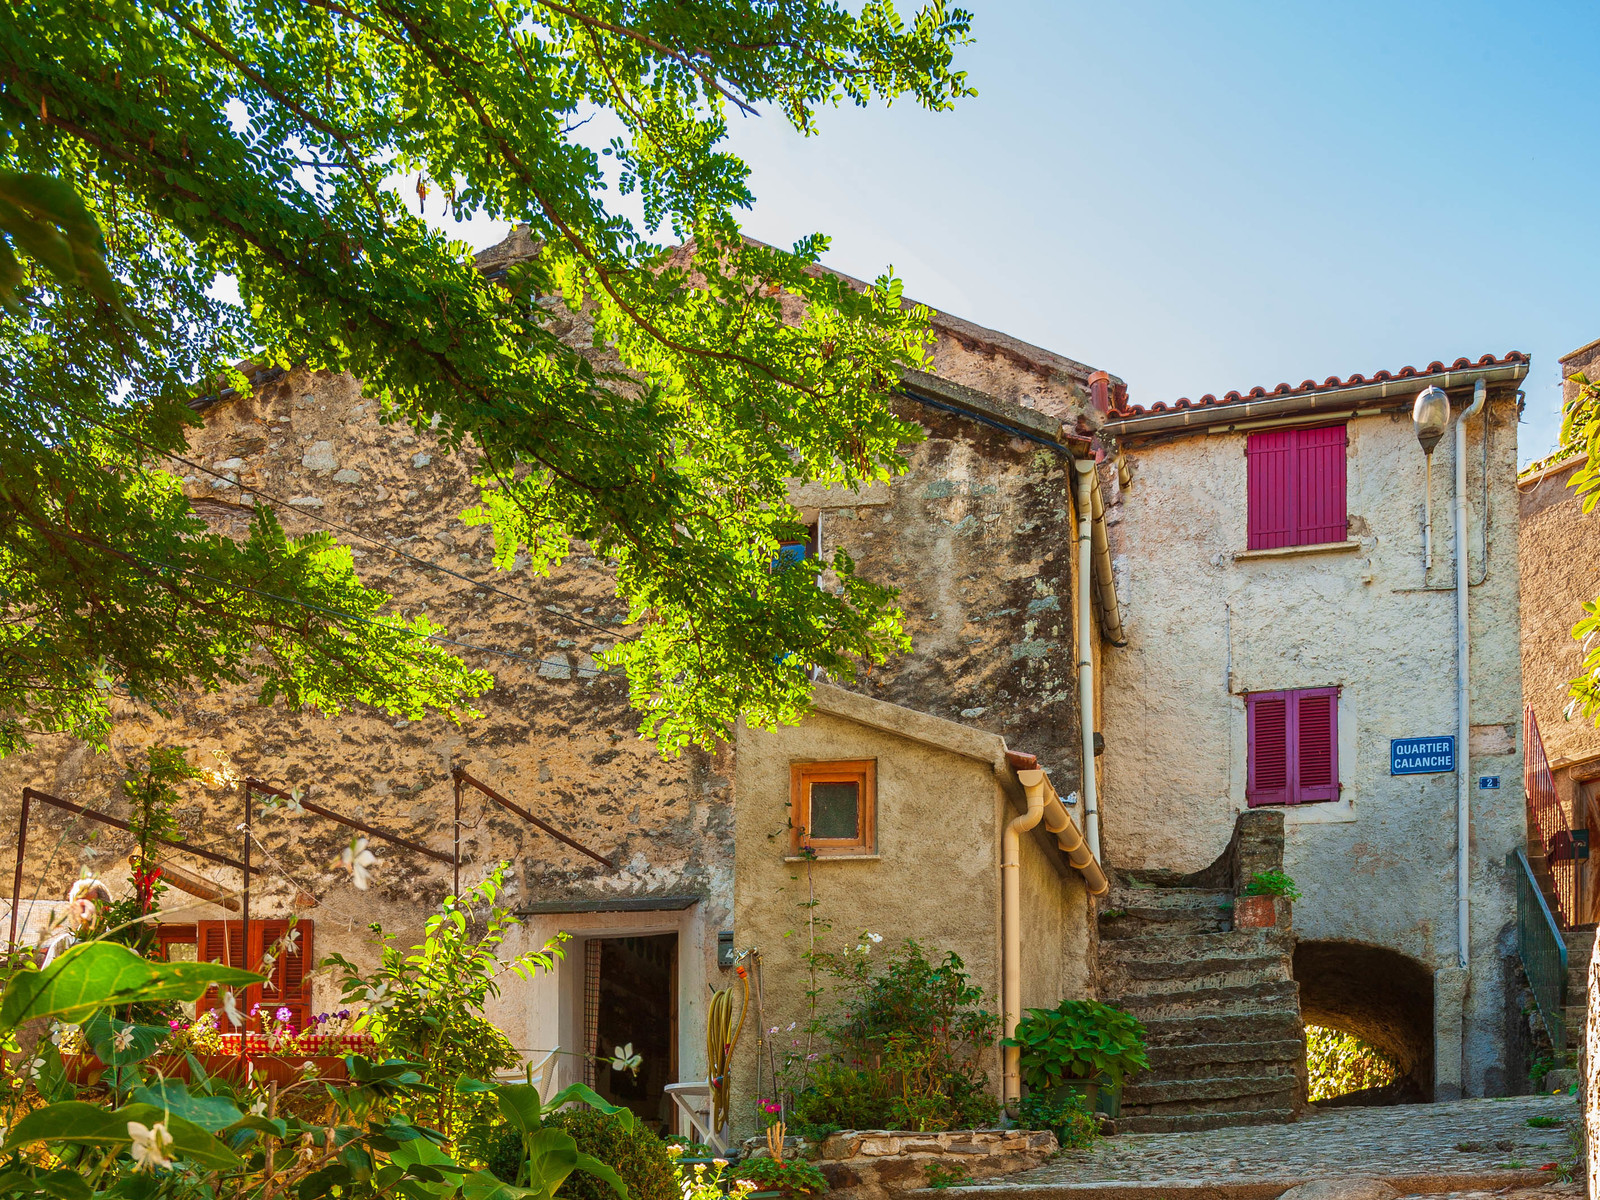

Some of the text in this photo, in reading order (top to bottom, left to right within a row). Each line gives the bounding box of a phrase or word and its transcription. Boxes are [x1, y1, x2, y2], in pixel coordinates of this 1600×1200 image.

[1396, 742, 1450, 755] QUARTIER
[1394, 755, 1452, 769] CALANCHE
[1486, 778, 1493, 787] 2
